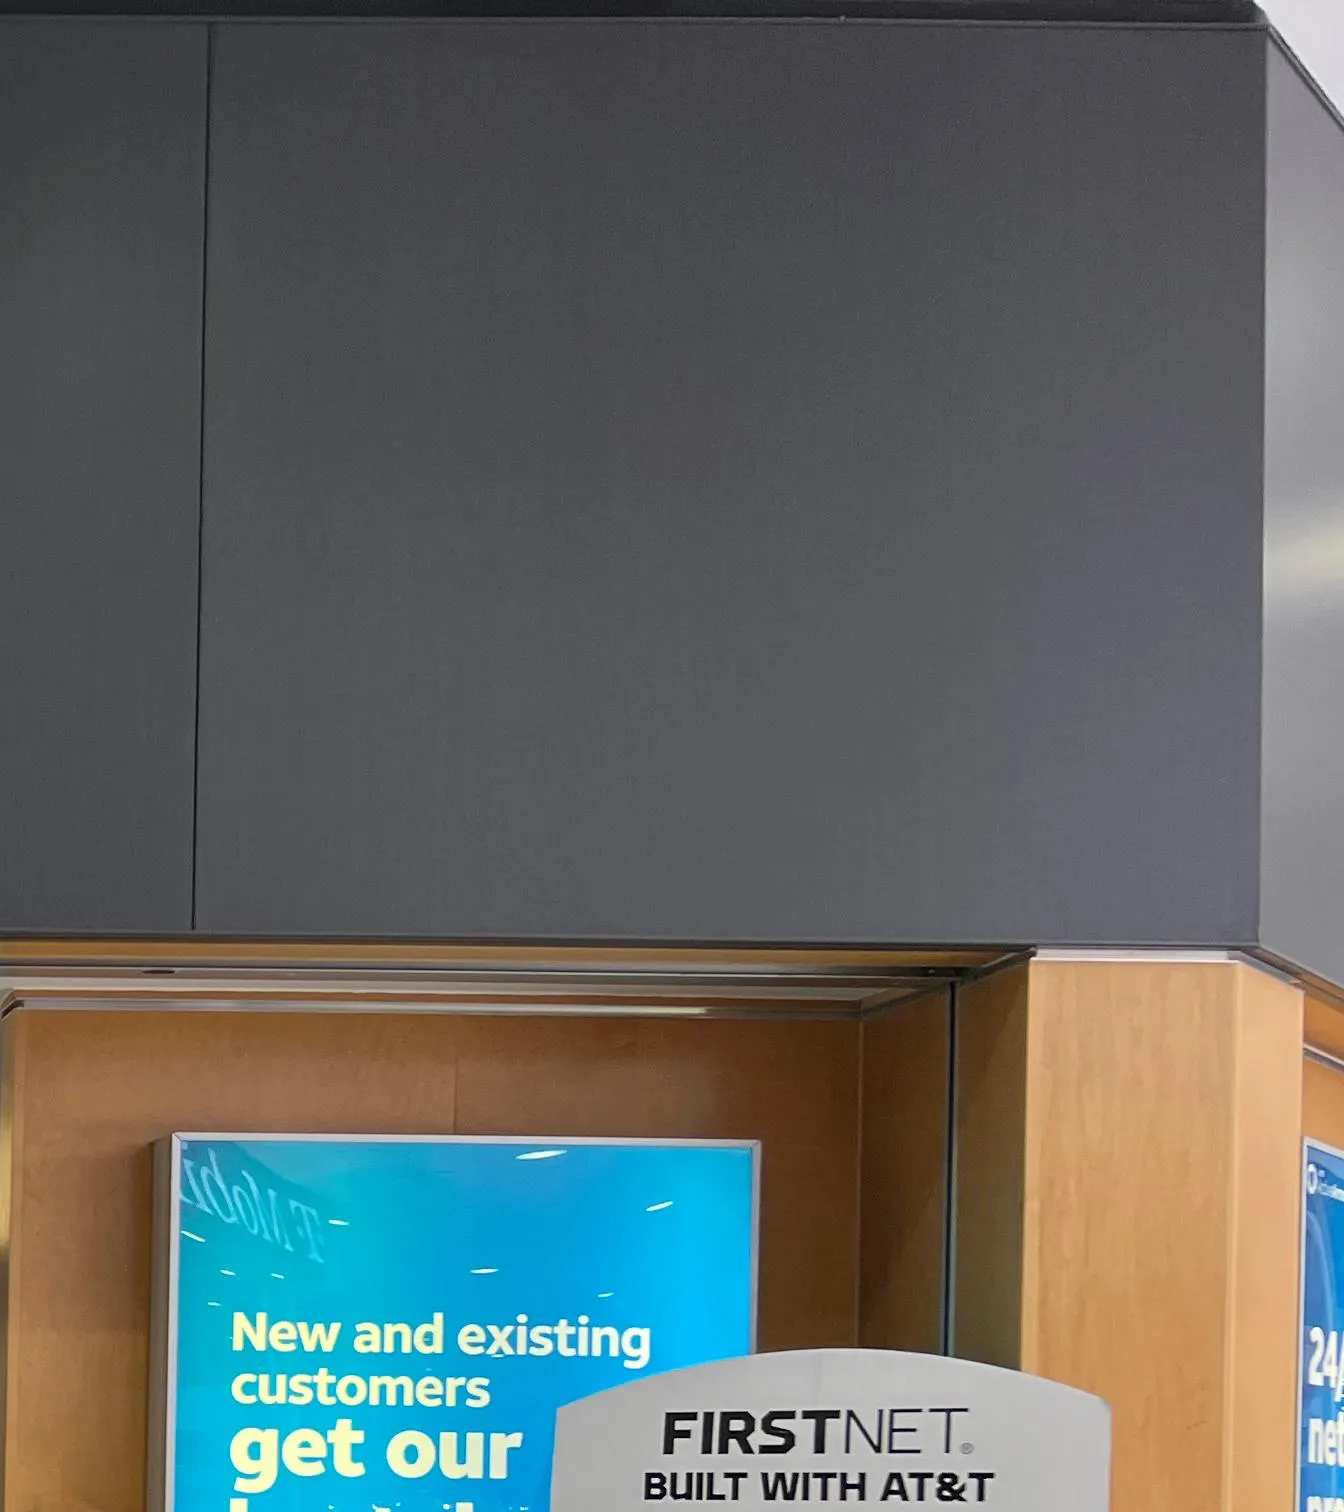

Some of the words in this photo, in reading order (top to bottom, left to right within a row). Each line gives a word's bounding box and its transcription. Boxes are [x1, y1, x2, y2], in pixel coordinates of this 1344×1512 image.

[231, 1312, 340, 1353] New
[353, 1312, 444, 1356] and
[457, 1314, 652, 1369] existing
[230, 1368, 491, 1407] customers
[229, 1418, 365, 1494] get
[386, 1430, 523, 1480] our
[643, 1472, 749, 1501] BUILT
[760, 1472, 866, 1501] WITH
[879, 1472, 996, 1502] AT&T
